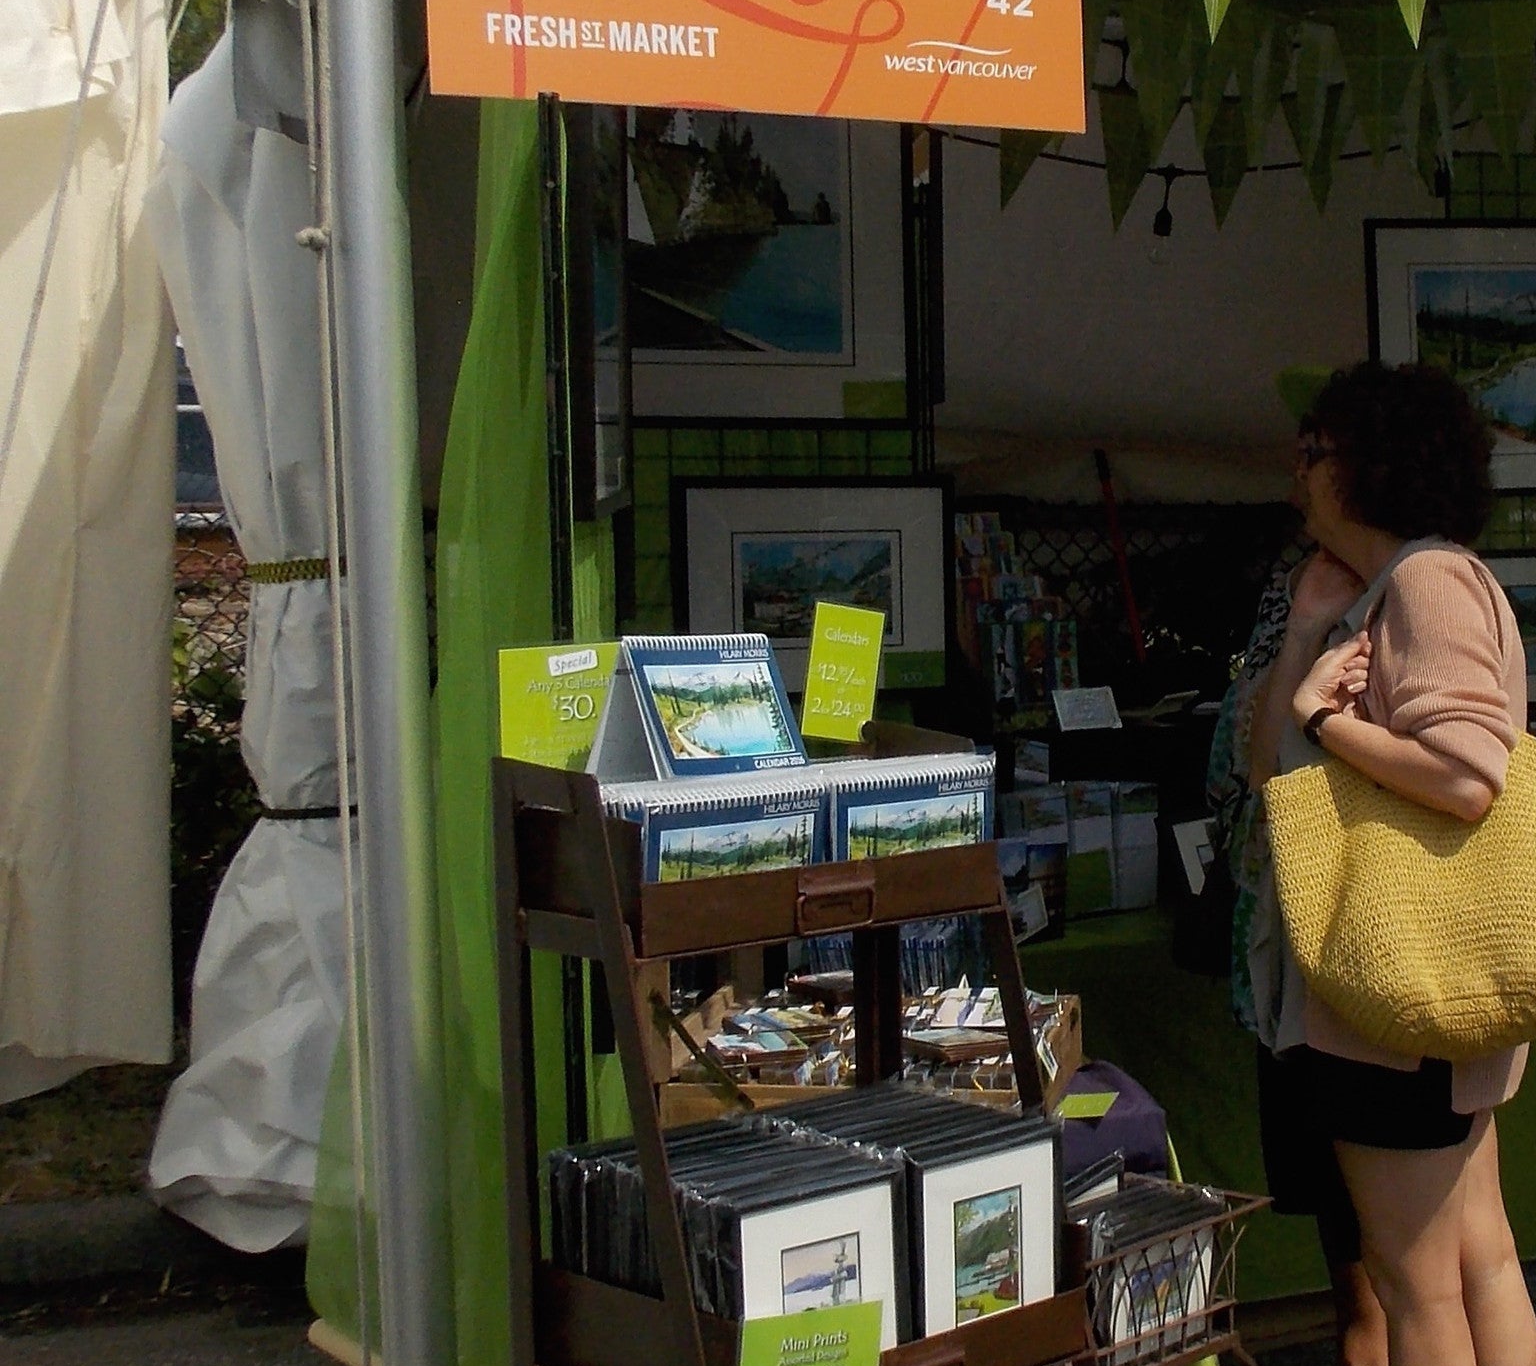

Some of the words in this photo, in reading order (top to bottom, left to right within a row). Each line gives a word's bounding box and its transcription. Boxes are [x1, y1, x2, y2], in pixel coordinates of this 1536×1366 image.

[486, 12, 577, 49] FRESH
[581, 20, 605, 43] ST.
[608, 20, 719, 58] MARKET
[824, 626, 870, 647] Calendars
[719, 650, 742, 659] HILARY
[744, 648, 769, 658] MORRIS
[554, 651, 592, 673] Special
[528, 678, 554, 694] Any
[755, 757, 790, 770] CALENDAR
[938, 782, 962, 793] HILARY
[963, 777, 989, 790] MORRIS
[763, 803, 791, 814] HILARY
[792, 799, 820, 811] MORRIS
[780, 1336, 810, 1354] Mini
[813, 1329, 848, 1348] Prints
